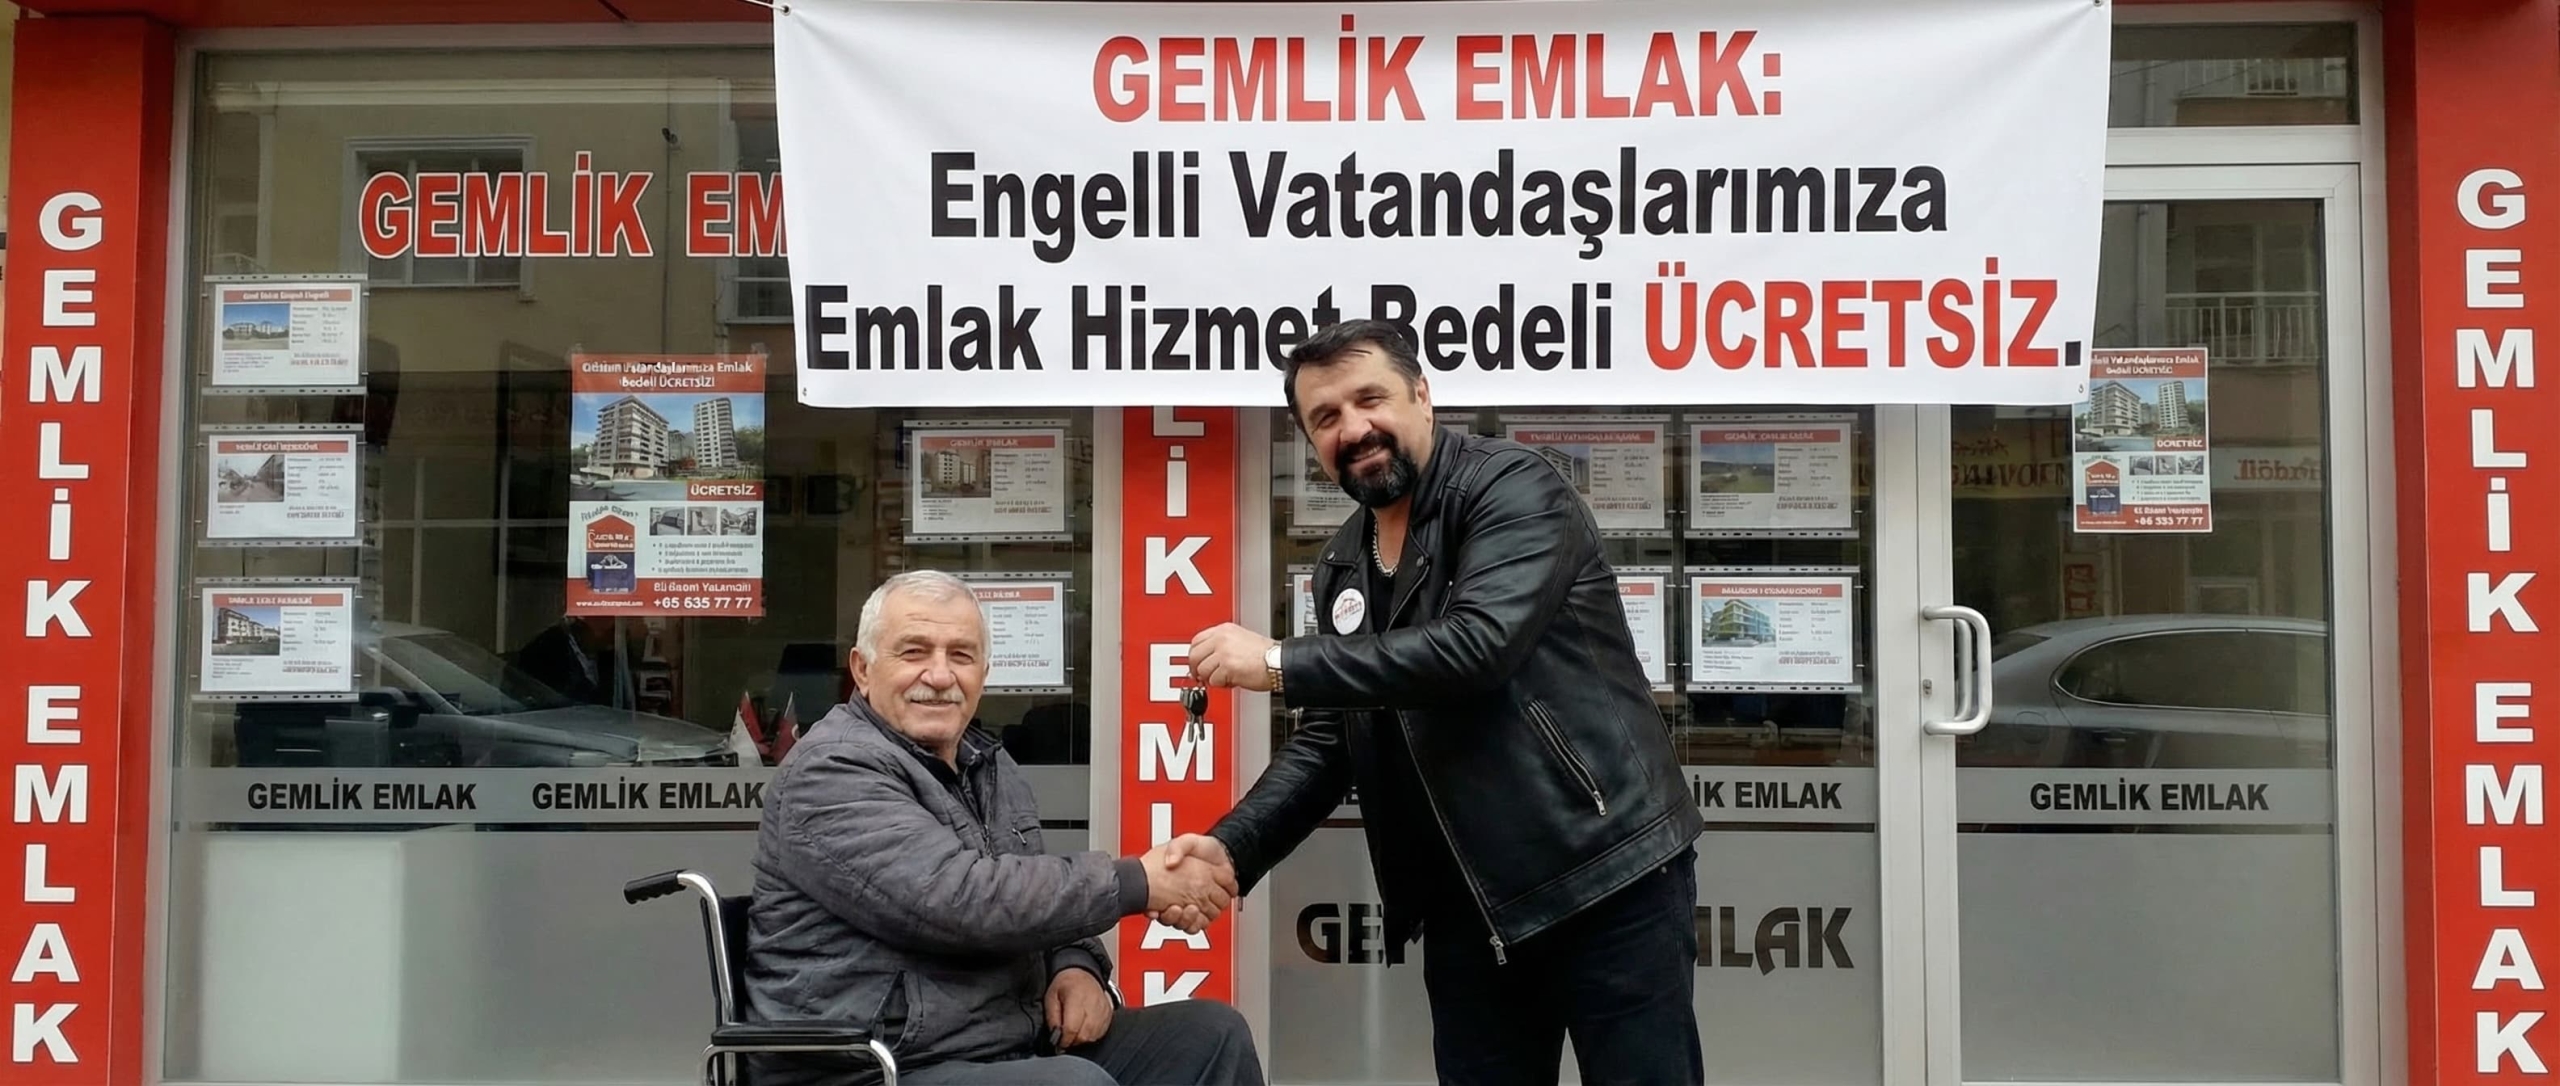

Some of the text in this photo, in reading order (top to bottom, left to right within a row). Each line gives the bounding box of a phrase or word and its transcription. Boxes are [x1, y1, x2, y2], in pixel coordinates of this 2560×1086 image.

[1093, 14, 1783, 123] GEMLİK EMLAK:
[359, 151, 653, 259] GEMLİK
[930, 146, 1948, 264] Engelli Vatandaşlarımıza
[804, 284, 1043, 371] Emlak
[1645, 257, 2082, 370] ÜCRETSİZ.
[11, 191, 104, 1064] GEMLİK EMLAK
[714, 597, 730, 609] 77
[735, 597, 752, 609] 77
[2455, 168, 2548, 1075] GEMLİK EMLAK
[247, 777, 478, 810] GEMLİK EMLAK
[532, 776, 765, 810] GEMLİK EMLAK
[1734, 782, 1843, 809] EMLAK
[2029, 777, 2270, 811] GEMLİK EMLAK
[1695, 906, 1855, 976] LAK
